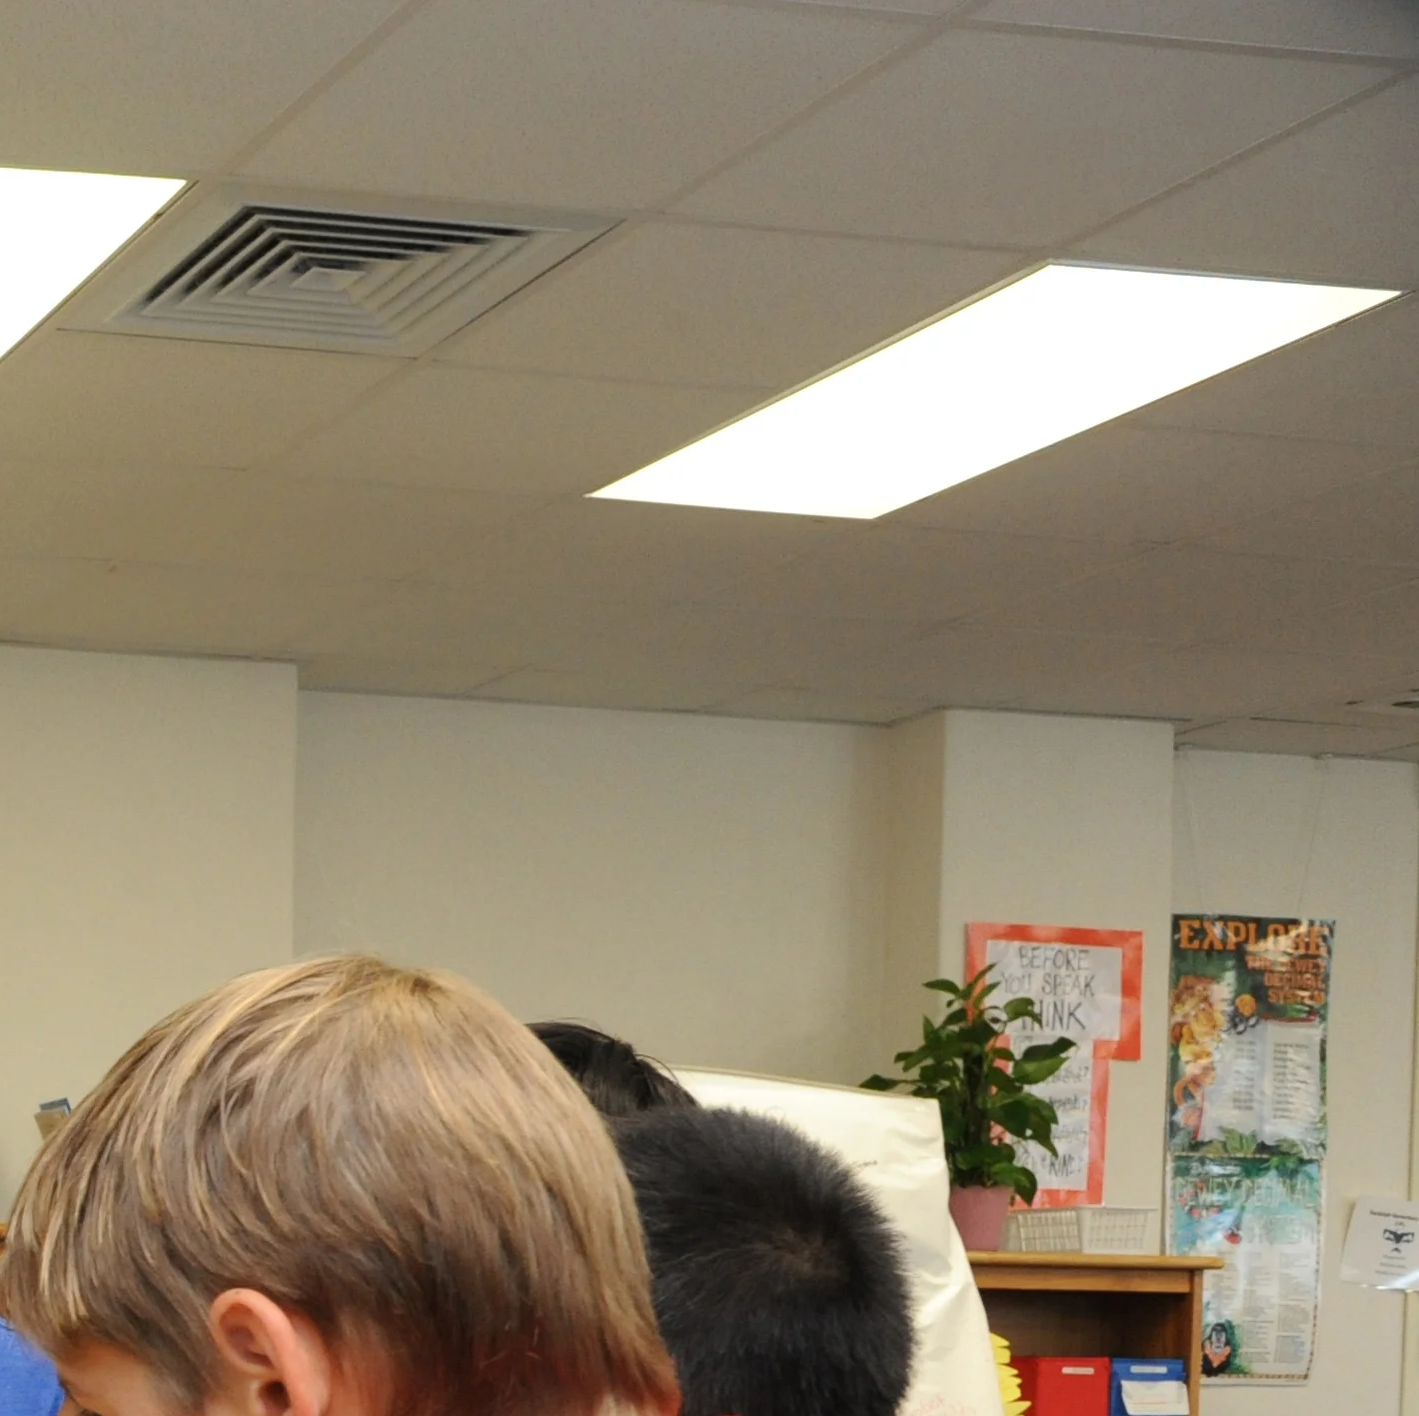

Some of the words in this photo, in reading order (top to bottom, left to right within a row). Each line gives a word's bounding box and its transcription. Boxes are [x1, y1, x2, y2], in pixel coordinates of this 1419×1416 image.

[1017, 945, 1091, 972] BEFORE
[1001, 970, 1032, 997] YOU
[1040, 972, 1096, 999] SPEAK
